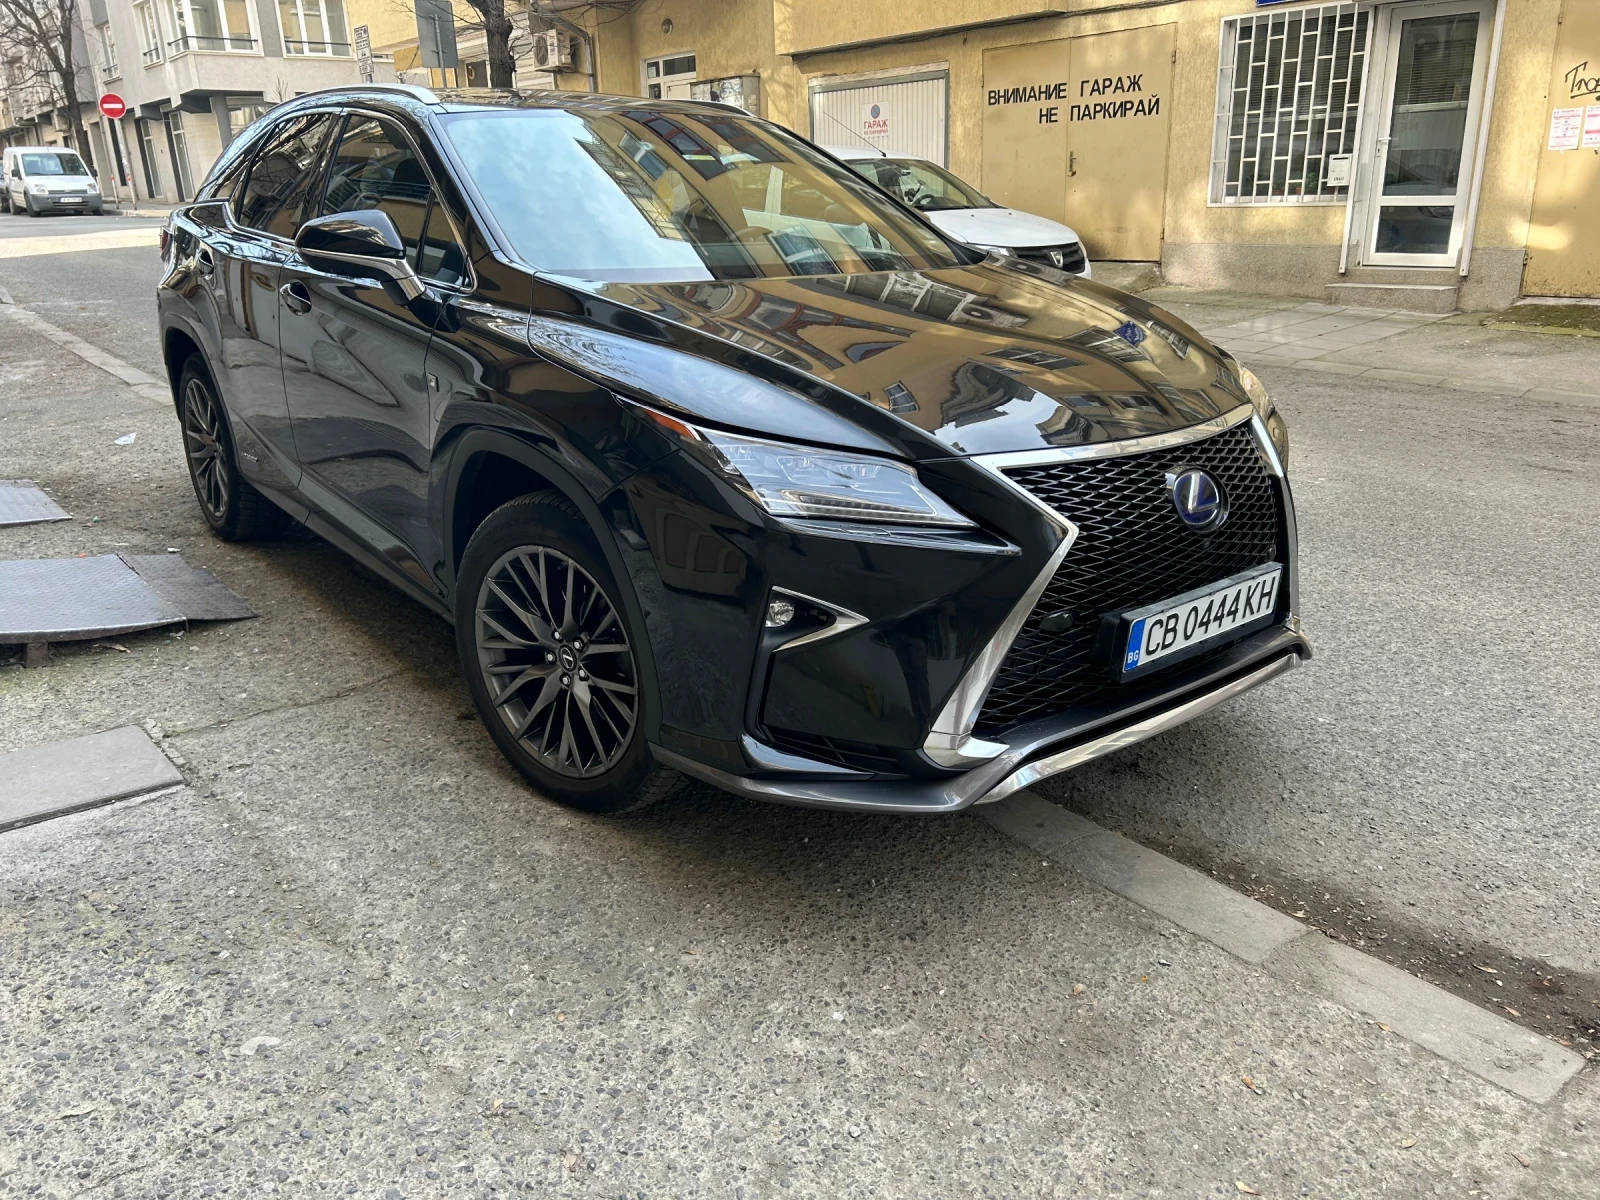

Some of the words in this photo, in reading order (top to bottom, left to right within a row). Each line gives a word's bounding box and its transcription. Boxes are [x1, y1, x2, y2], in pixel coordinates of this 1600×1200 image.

[988, 83, 1067, 106] ВНИМАНИЕ
[1080, 74, 1143, 97] ГАРАЖ
[1039, 107, 1058, 124] НЕ
[1070, 94, 1160, 121] ПАРКИРАЙ
[864, 119, 888, 129] ГАРАЖ
[1127, 650, 1139, 664] BG
